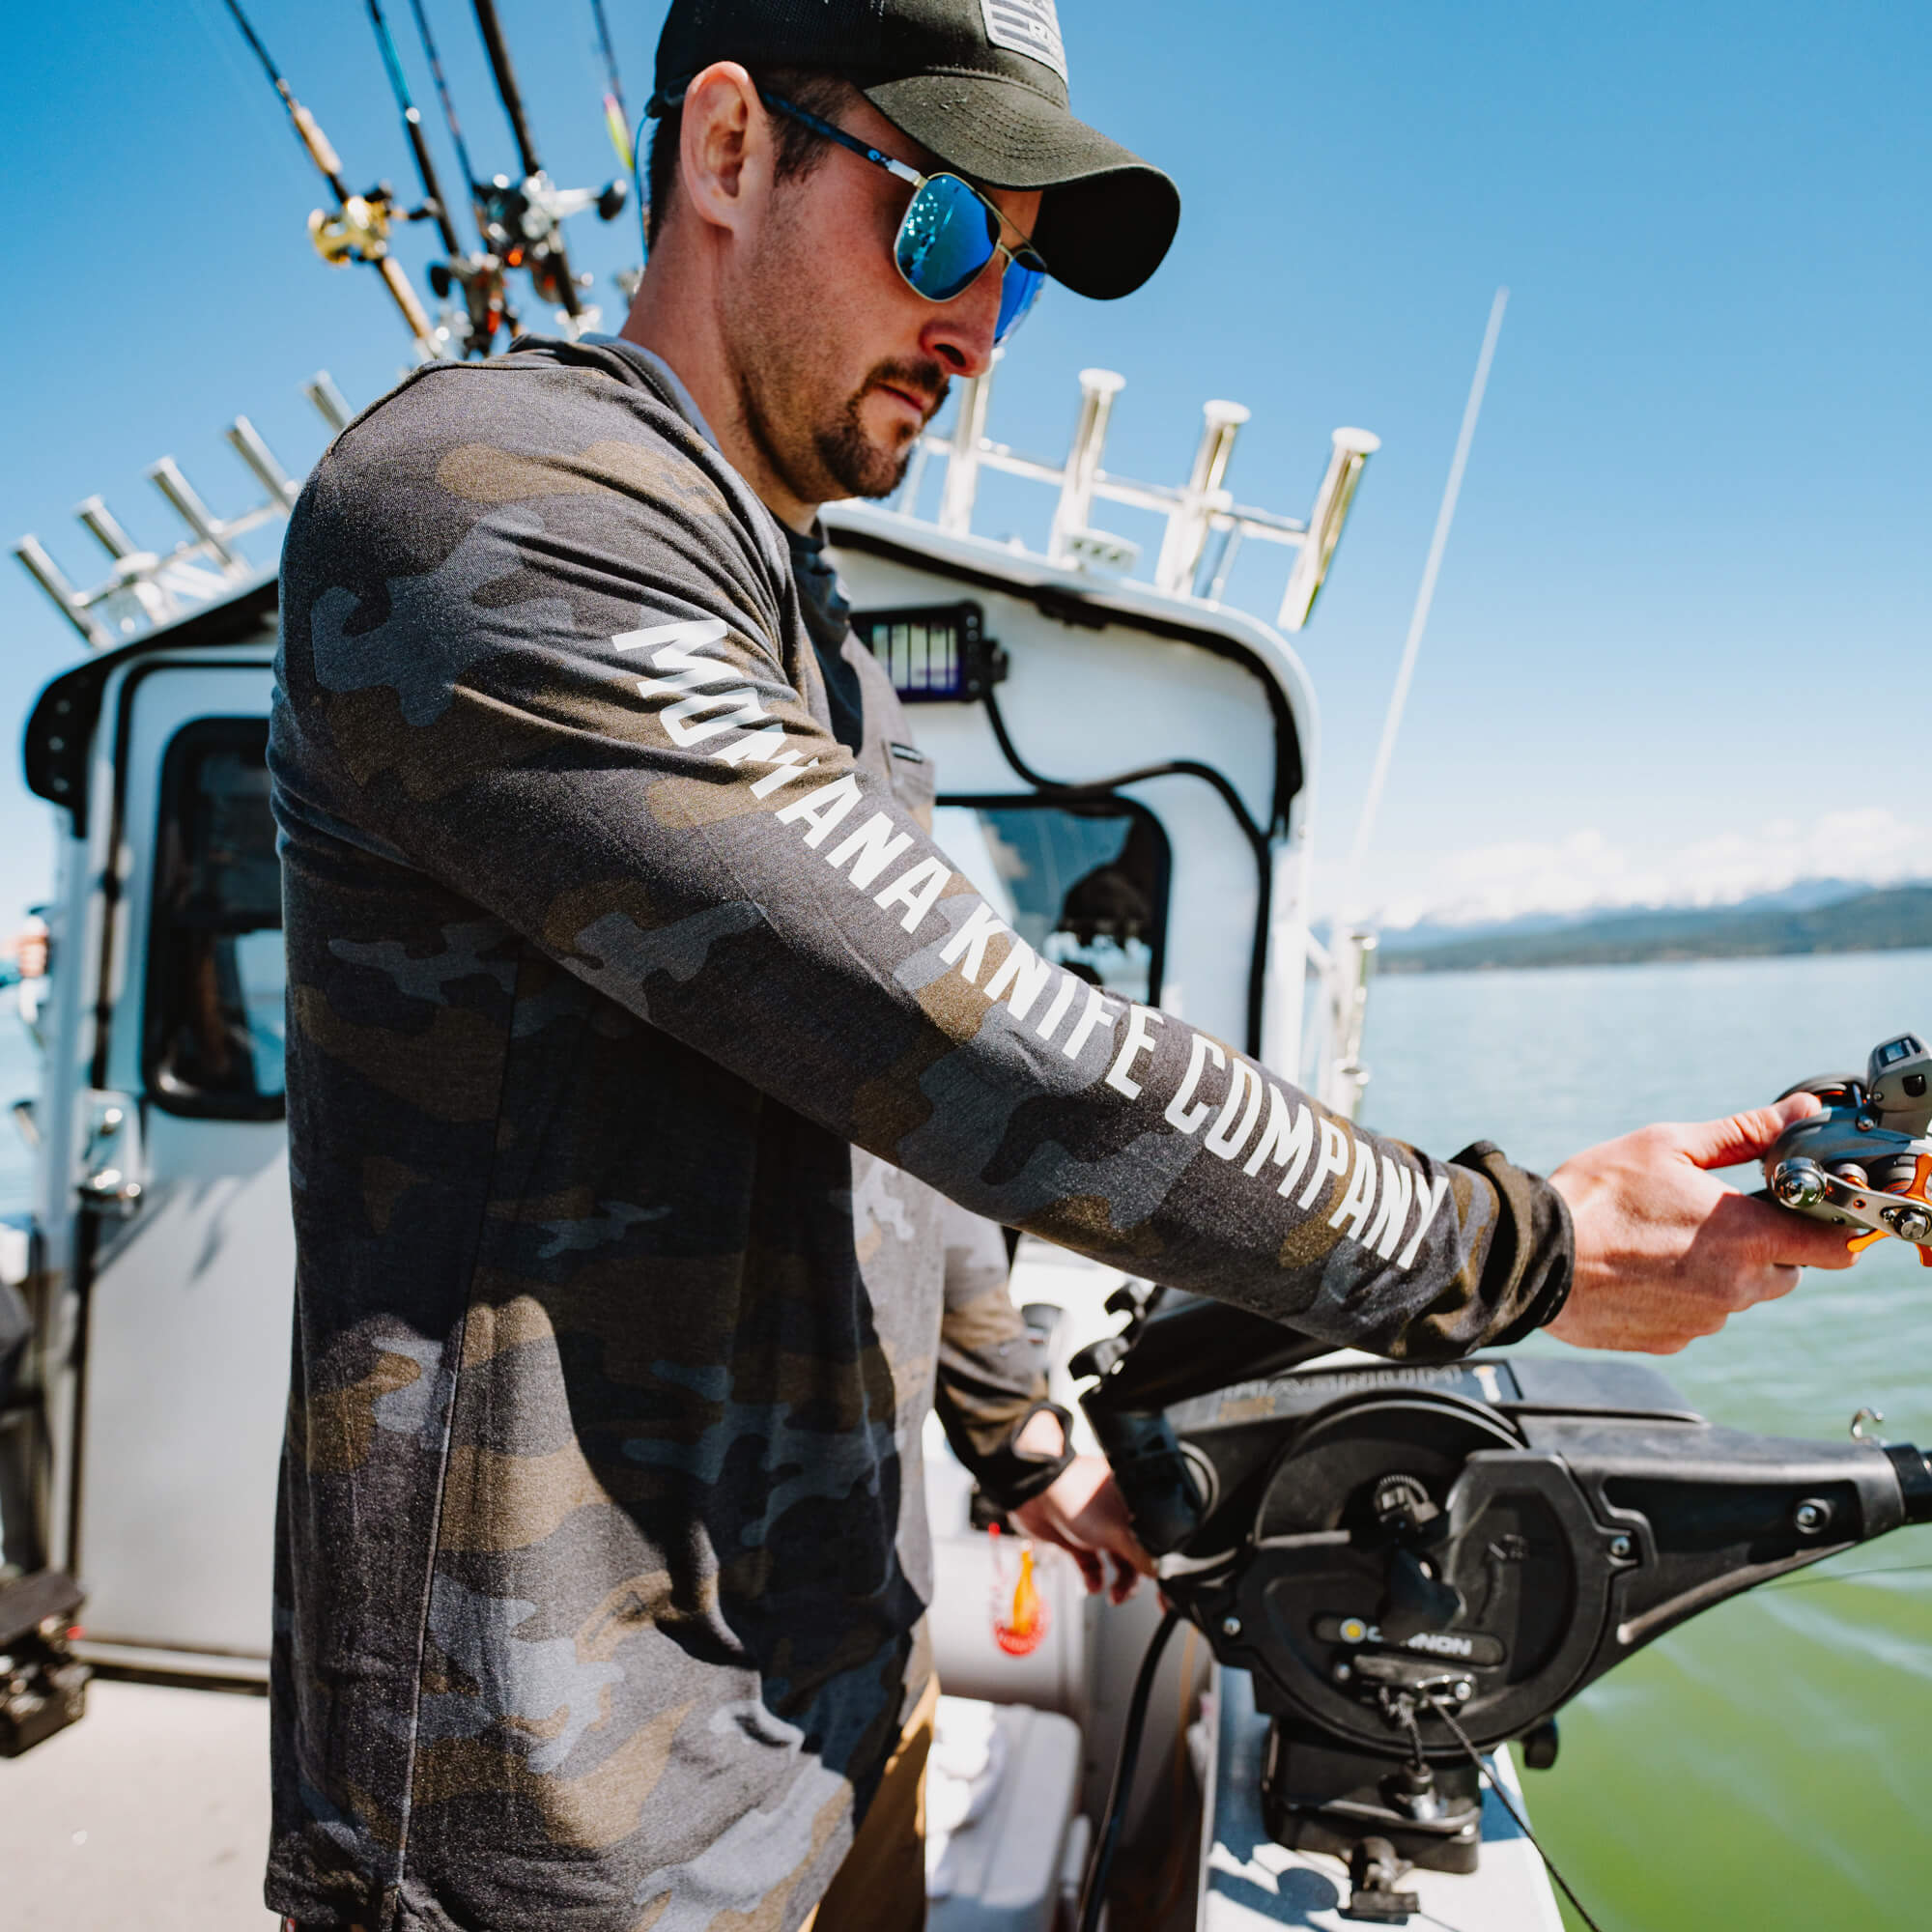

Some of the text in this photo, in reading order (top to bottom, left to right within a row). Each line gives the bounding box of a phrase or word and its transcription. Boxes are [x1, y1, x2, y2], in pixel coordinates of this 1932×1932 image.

[611, 619, 1449, 1270] MONTANA KNIFE COMPANY
